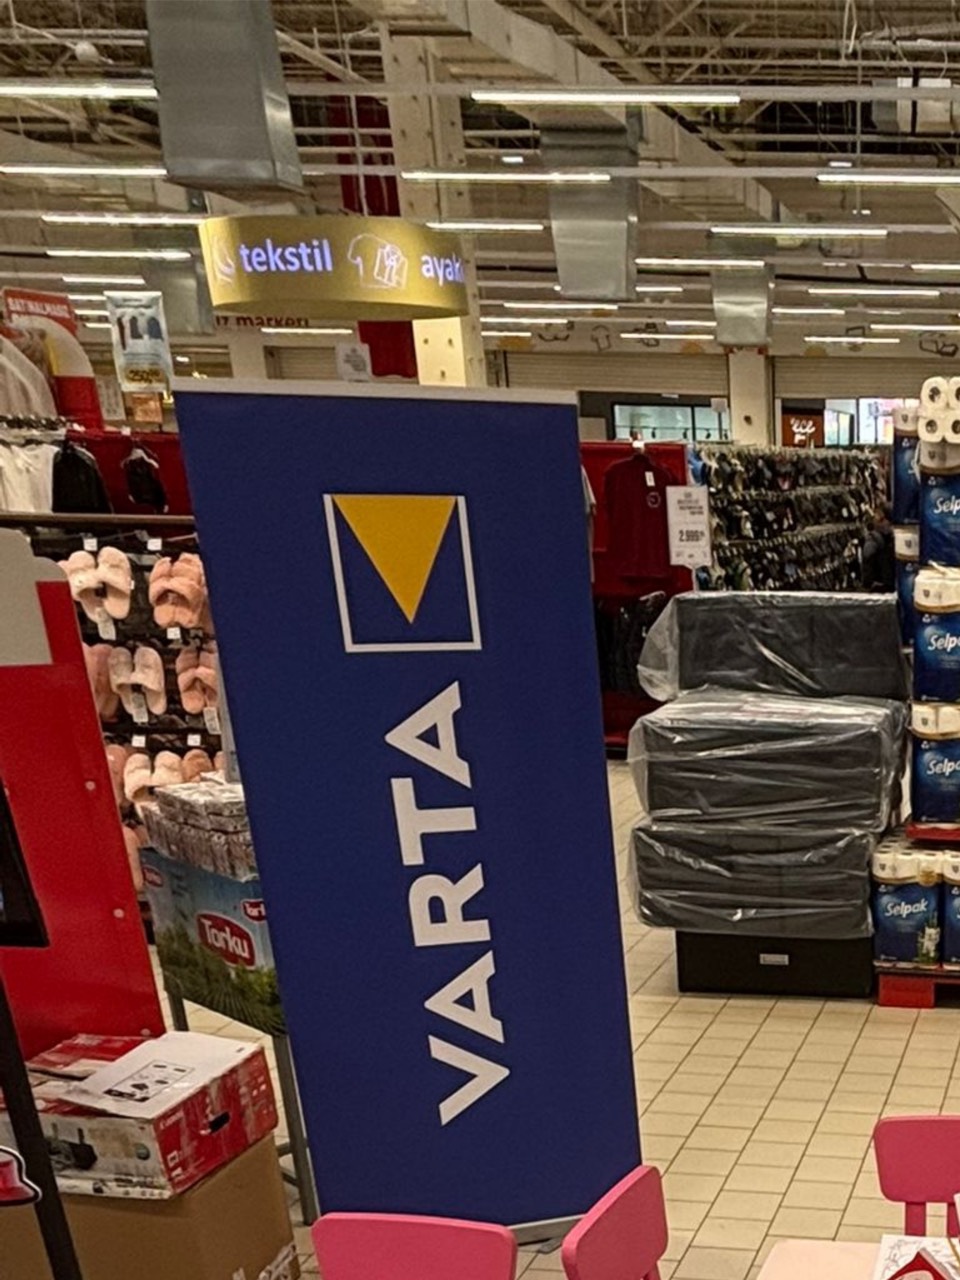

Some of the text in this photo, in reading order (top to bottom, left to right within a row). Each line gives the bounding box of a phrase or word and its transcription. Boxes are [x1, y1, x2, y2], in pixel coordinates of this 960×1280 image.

[239, 238, 333, 273] tekstil
[384, 680, 510, 1126] VARTA
[884, 899, 929, 918] Selpak
[200, 917, 251, 960] Torku
